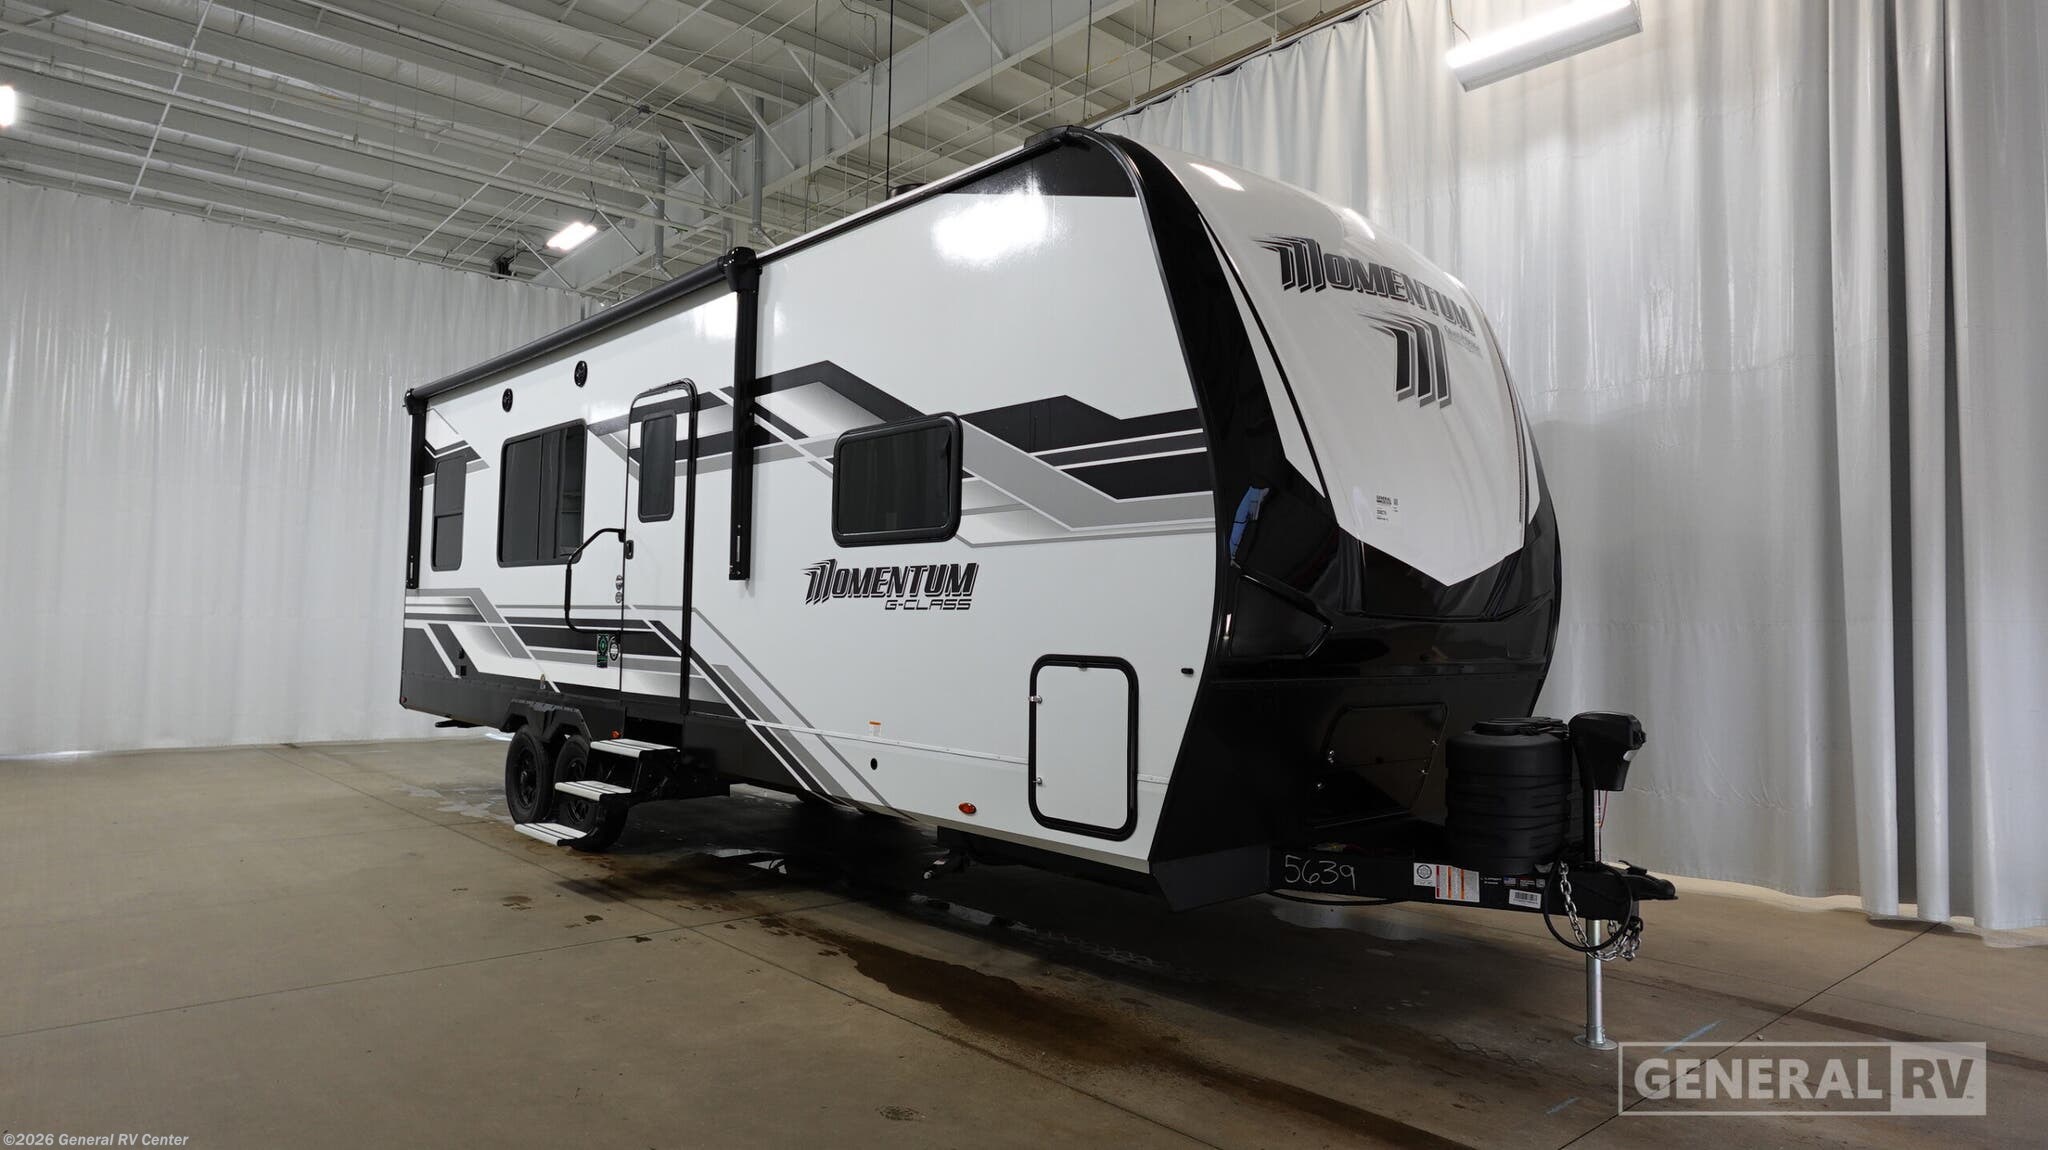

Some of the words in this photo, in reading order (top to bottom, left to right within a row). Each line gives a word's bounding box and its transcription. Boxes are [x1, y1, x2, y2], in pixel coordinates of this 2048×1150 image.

[1252, 235, 1476, 337] MOMENTUM
[801, 558, 980, 606] MOMENTUM
[884, 599, 973, 611] G-CLASS
[1284, 854, 1356, 891] 5639
